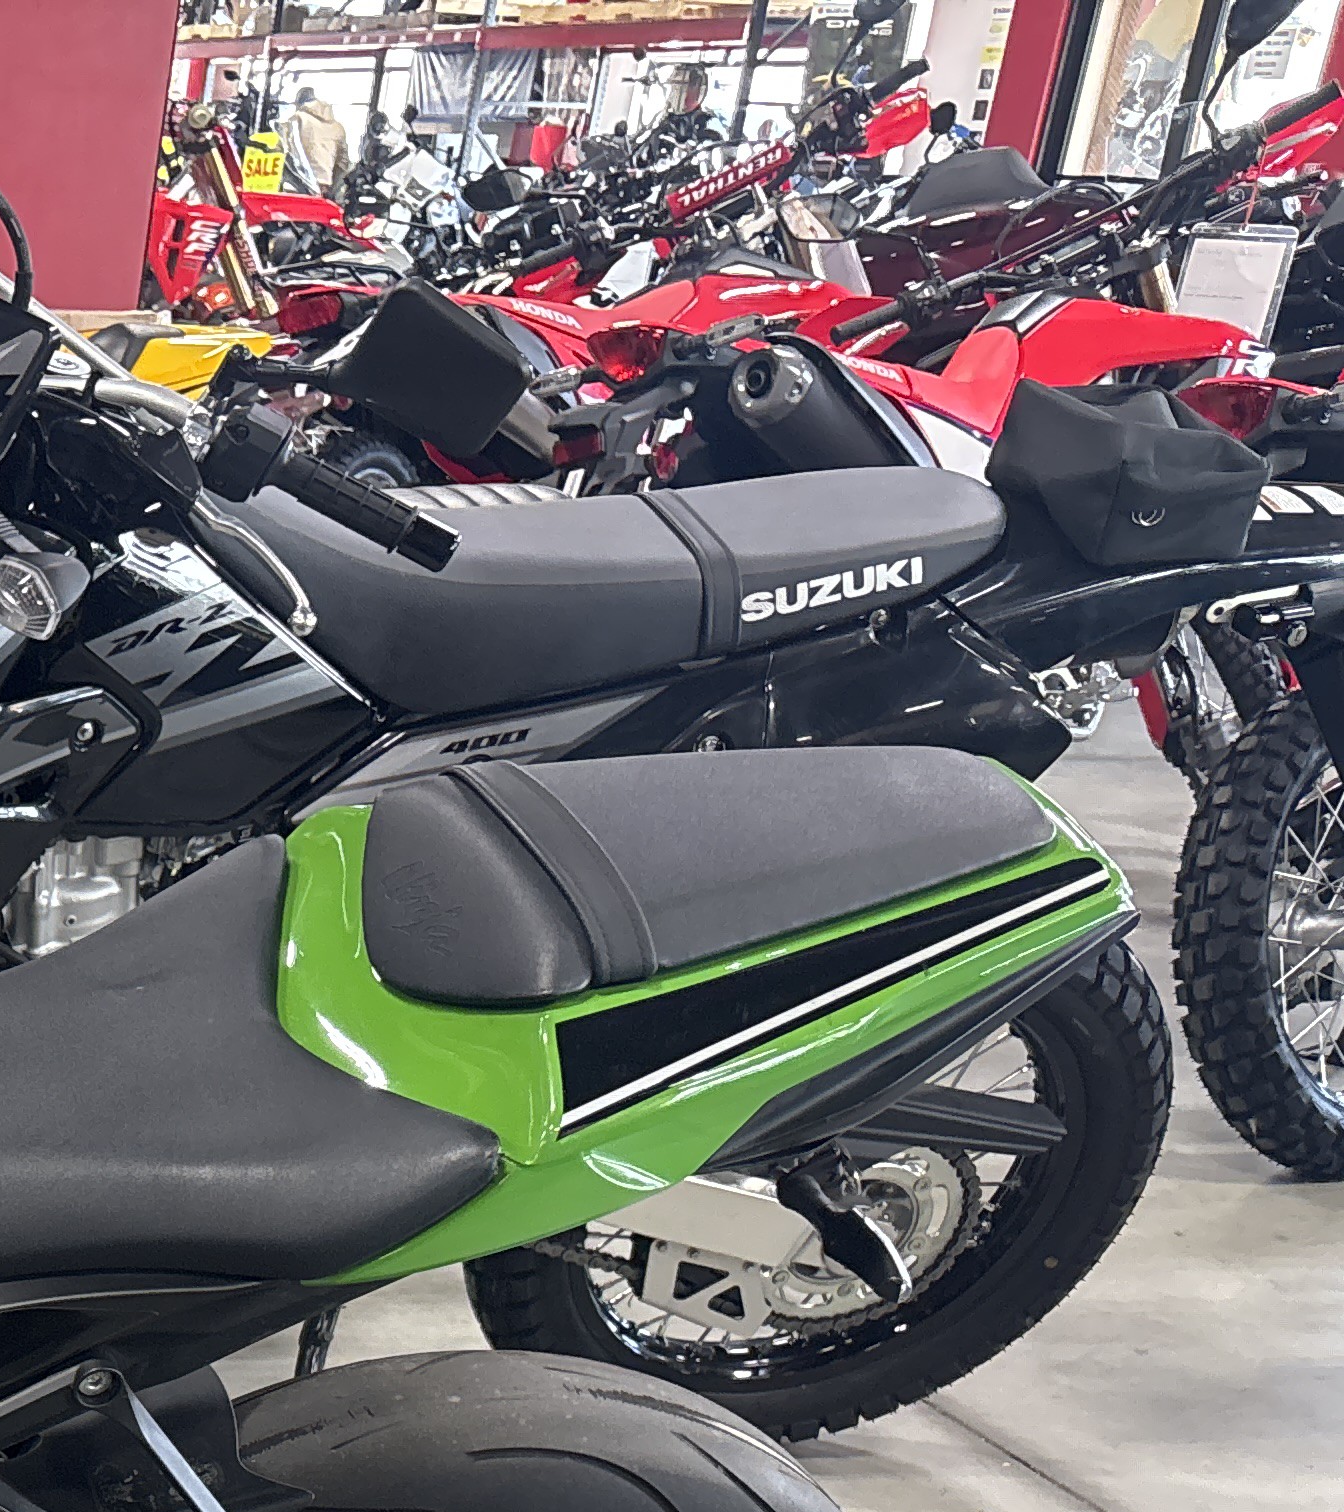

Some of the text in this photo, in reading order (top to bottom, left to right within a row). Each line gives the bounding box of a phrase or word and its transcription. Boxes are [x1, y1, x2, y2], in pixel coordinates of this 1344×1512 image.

[244, 157, 281, 178] SALE
[676, 147, 782, 207] RENTHAL
[508, 298, 583, 331] HONDA
[740, 556, 924, 622] SUZUKI
[439, 728, 531, 754] 400
